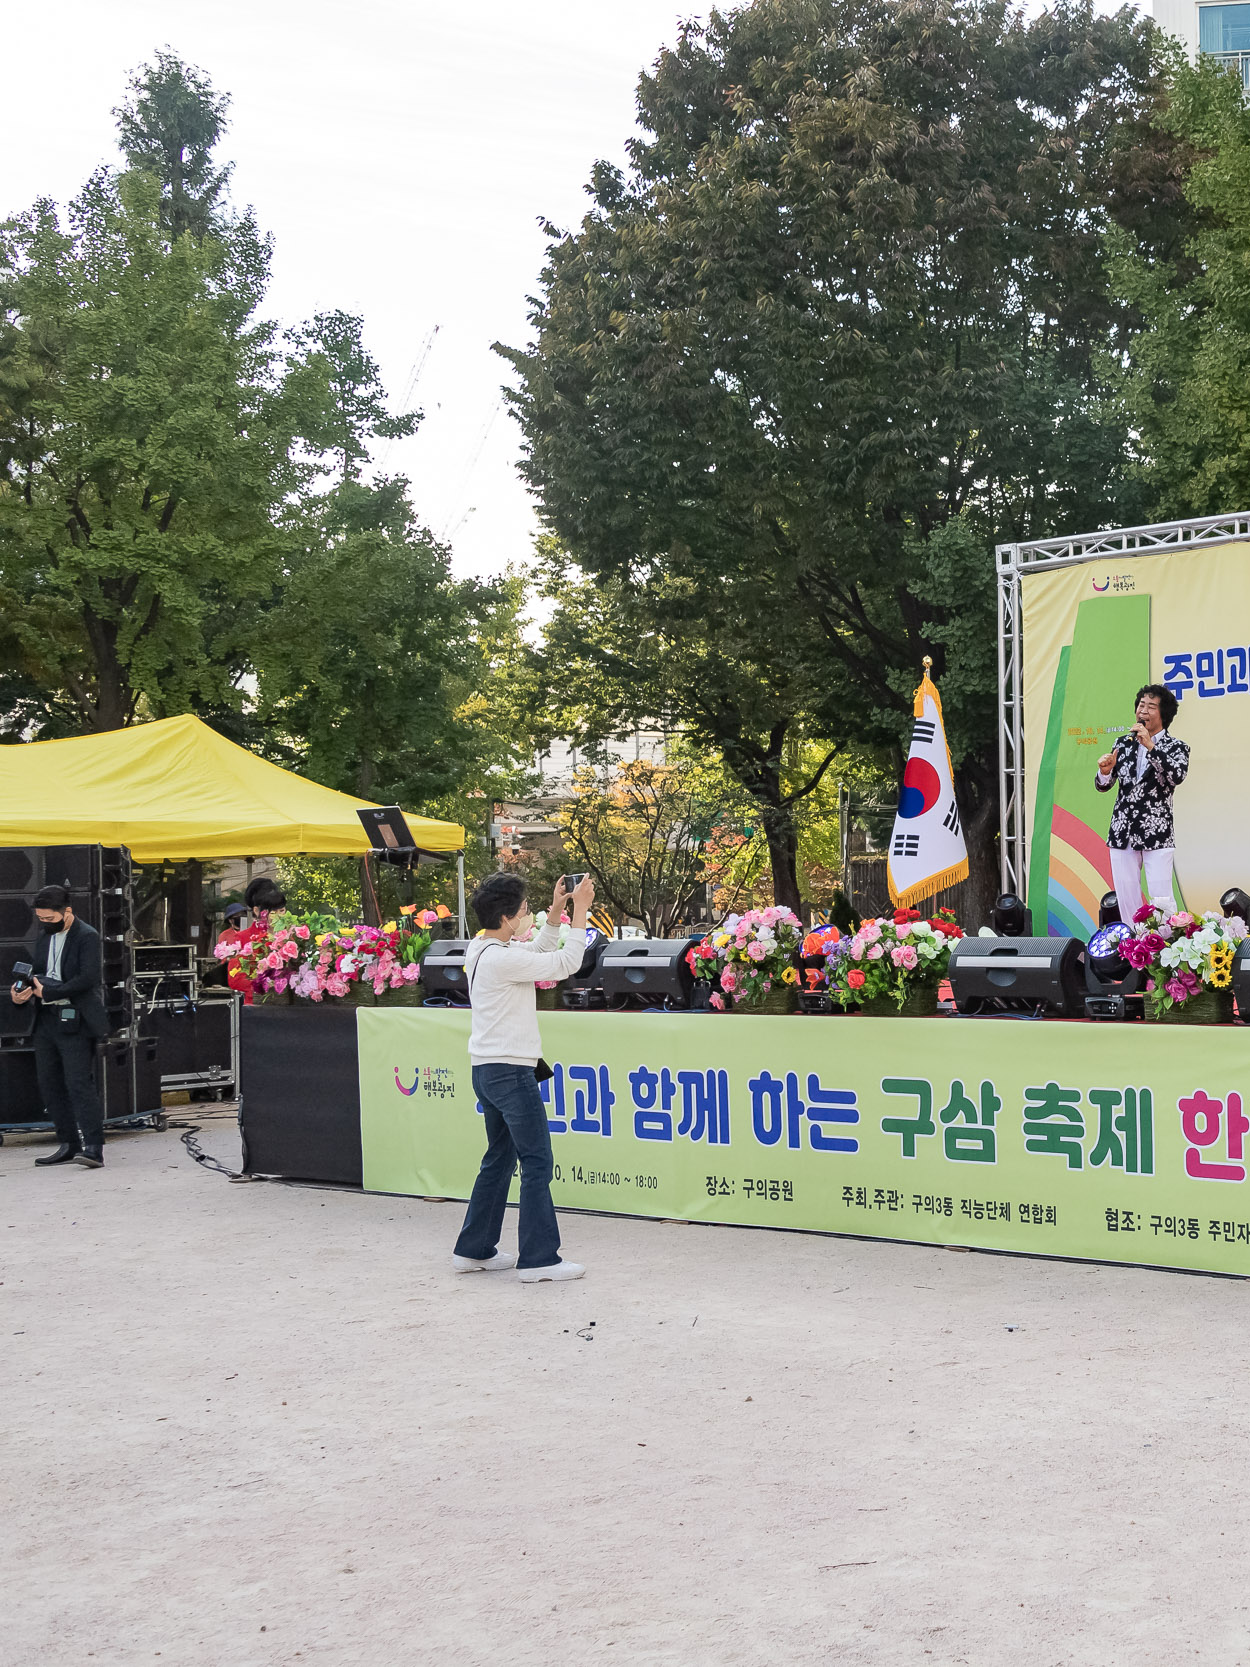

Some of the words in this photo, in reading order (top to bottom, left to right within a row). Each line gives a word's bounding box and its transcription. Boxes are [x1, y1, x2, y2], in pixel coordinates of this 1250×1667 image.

[423, 1080, 454, 1098] 행복광진
[628, 1065, 731, 1145] 함께
[748, 1070, 860, 1153] 하는
[880, 1077, 1002, 1164] 구삼
[1022, 1081, 1155, 1176] 축제
[635, 1175, 658, 1190] 18:00
[705, 1175, 735, 1197] 장소:
[742, 1178, 794, 1202] 구의공원
[912, 1194, 954, 1217] 구의3동
[960, 1199, 1011, 1222] 직능단체
[1018, 1203, 1057, 1226] 연합회
[1104, 1207, 1141, 1232] 협조:
[1150, 1214, 1200, 1240] 구의3동
